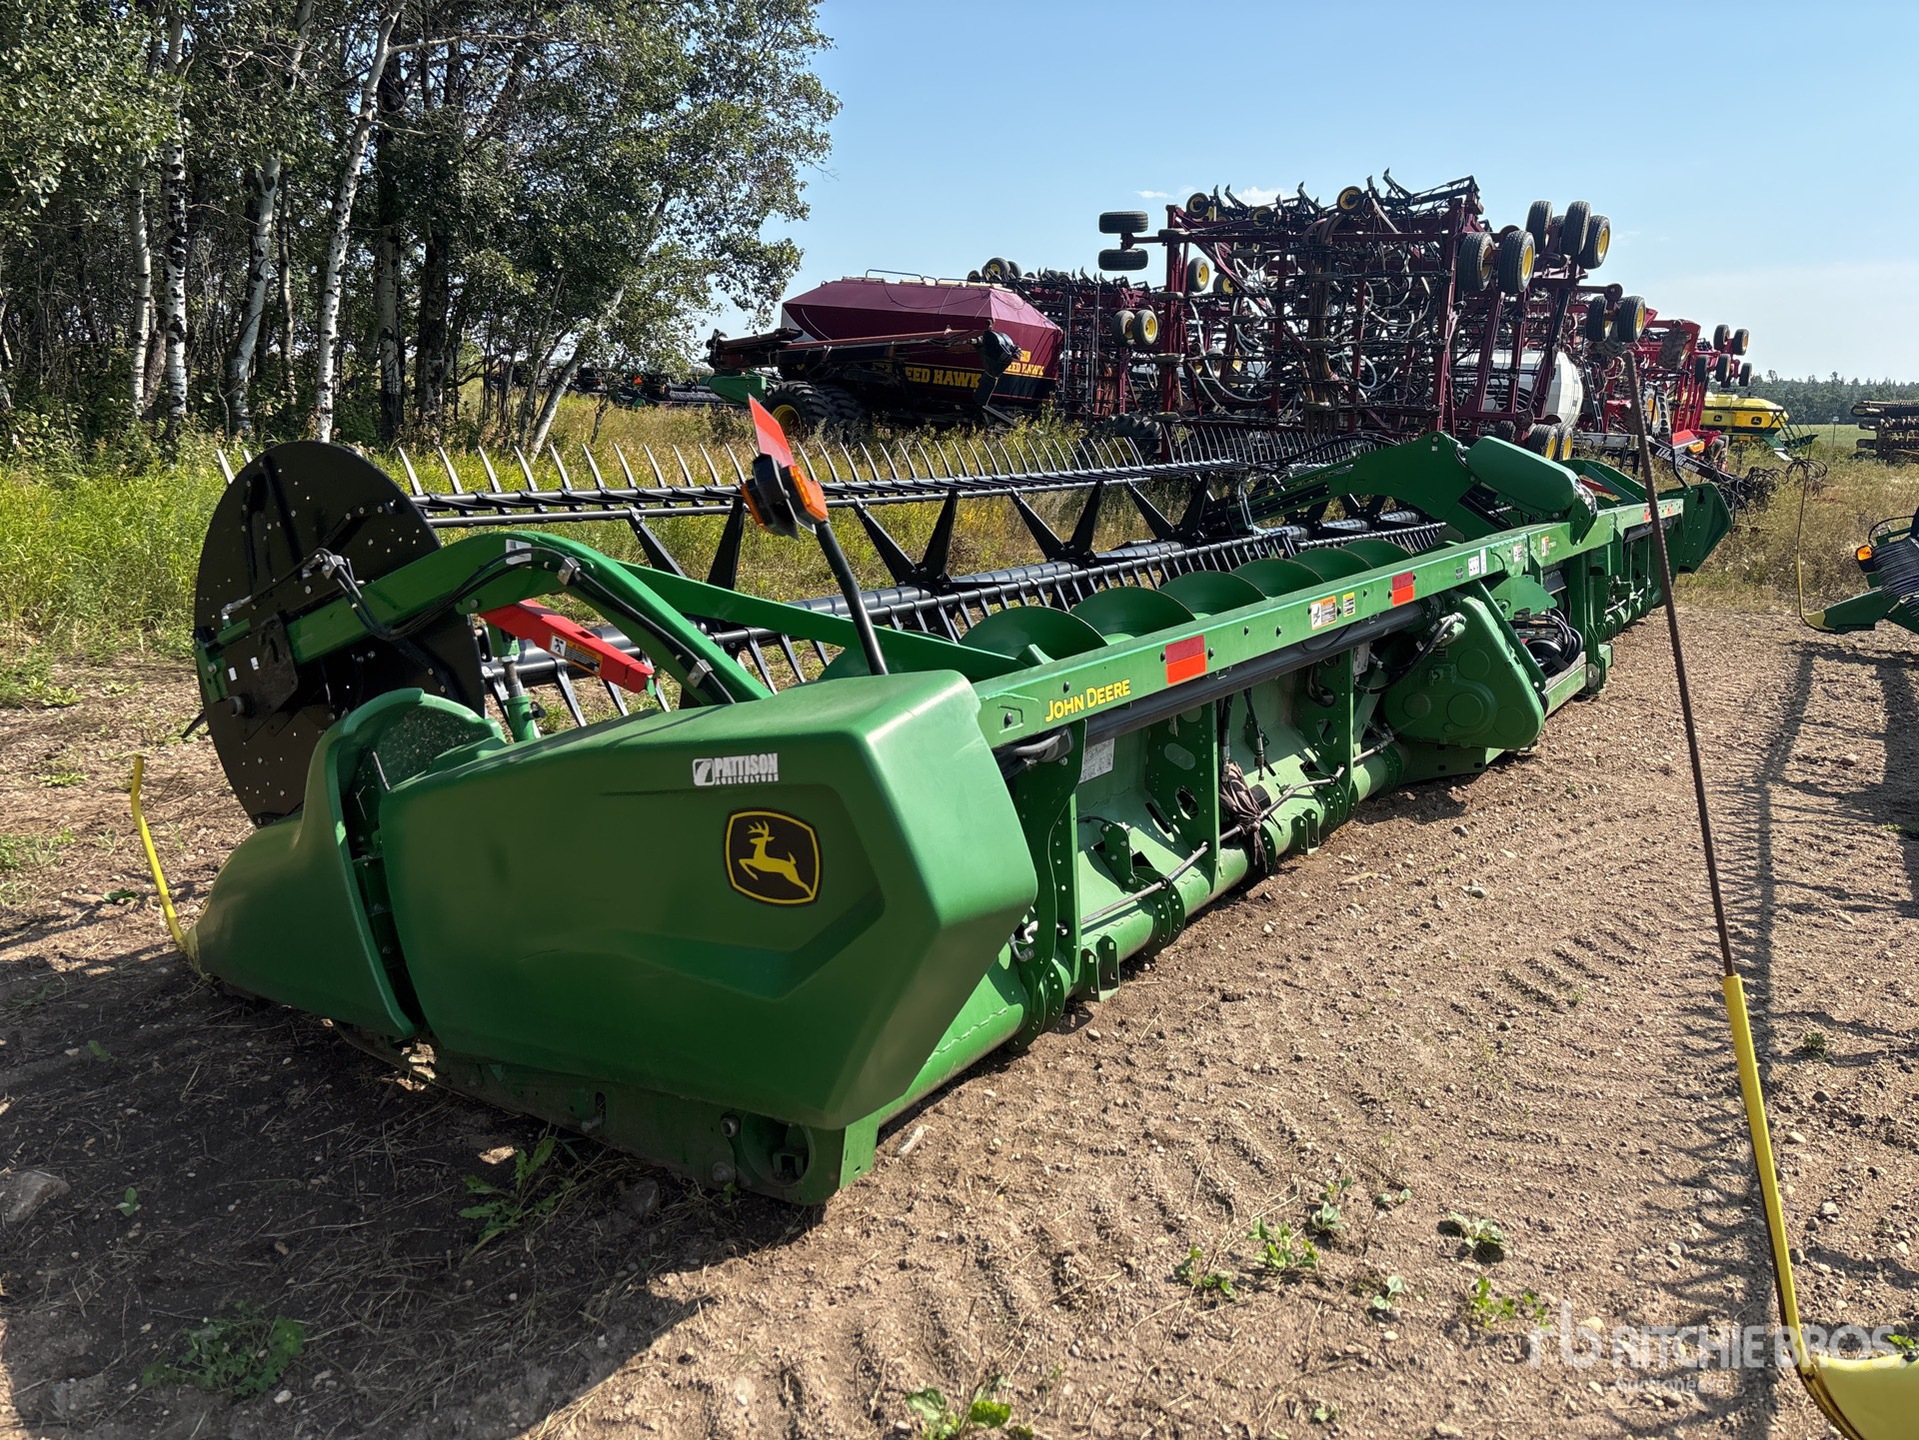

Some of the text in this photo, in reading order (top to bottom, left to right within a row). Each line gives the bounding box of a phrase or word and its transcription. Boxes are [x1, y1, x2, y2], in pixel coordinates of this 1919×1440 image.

[902, 366, 982, 388] EED HAWK
[1045, 679, 1132, 723] JOHN DEERE
[714, 752, 778, 777] PATTISON
[715, 774, 779, 785] AGRICULTURE
